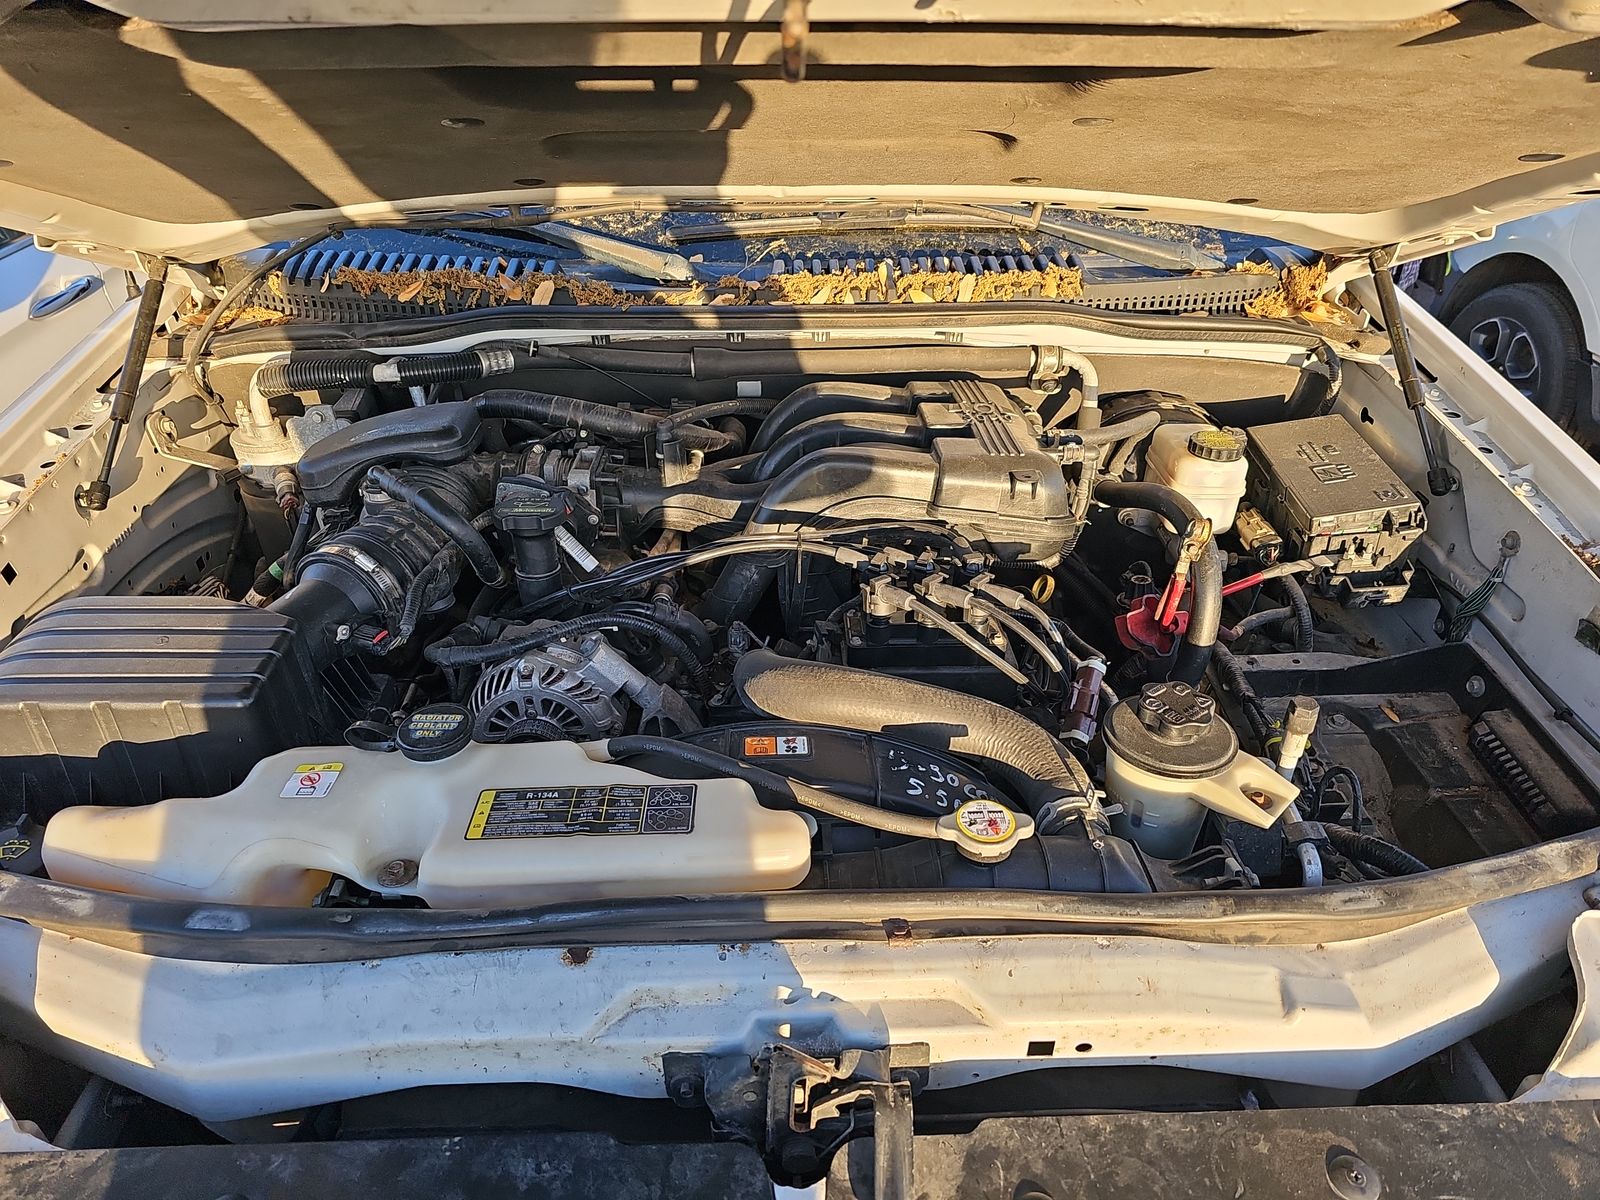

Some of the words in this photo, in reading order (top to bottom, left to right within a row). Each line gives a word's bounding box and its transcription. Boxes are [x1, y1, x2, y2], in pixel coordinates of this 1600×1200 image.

[412, 714, 464, 722] RADIATOR
[409, 722, 458, 730] COOLANT
[526, 791, 559, 799] R-134A
[884, 823, 912, 833] >EPDM<
